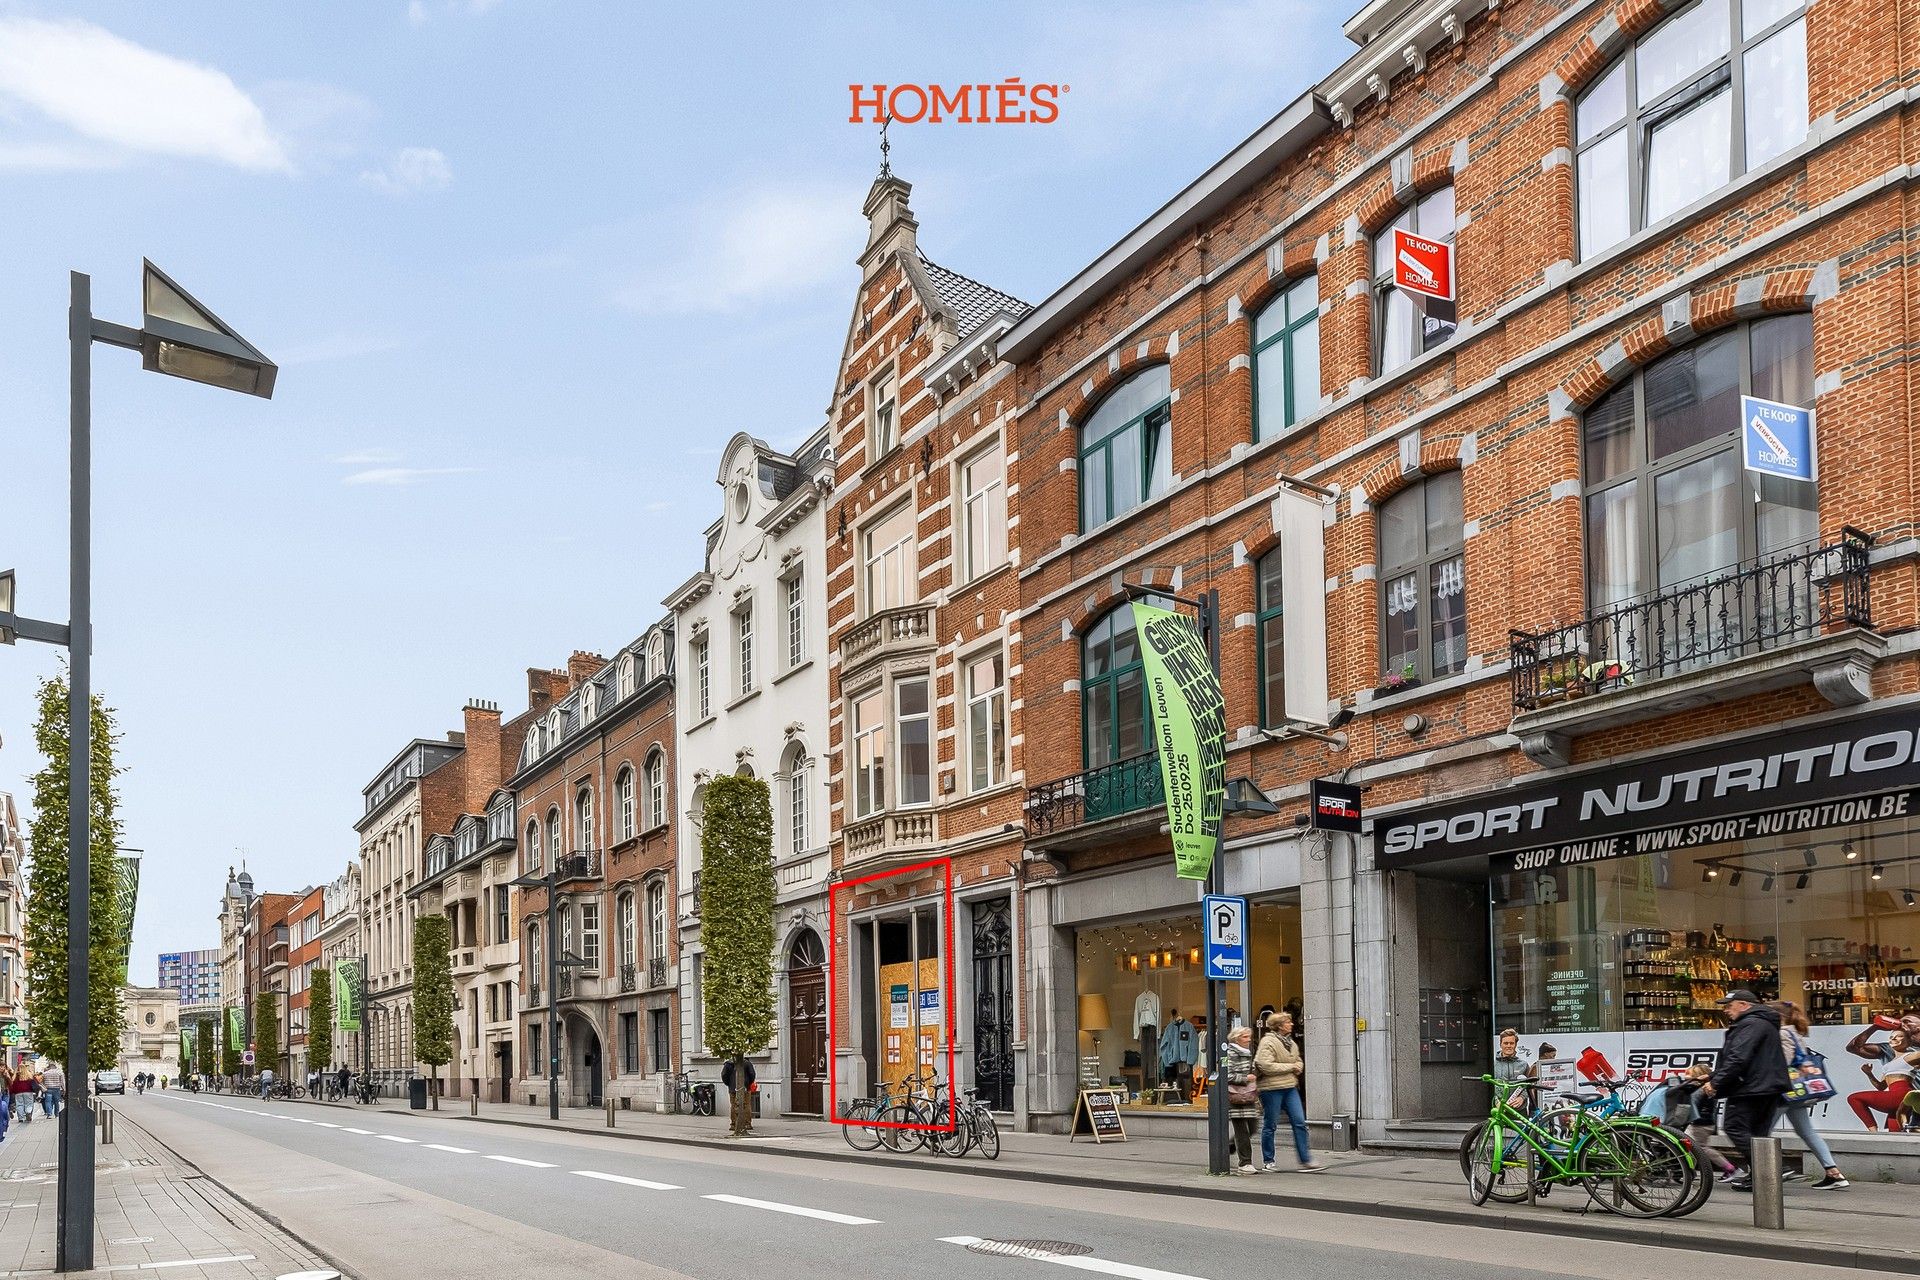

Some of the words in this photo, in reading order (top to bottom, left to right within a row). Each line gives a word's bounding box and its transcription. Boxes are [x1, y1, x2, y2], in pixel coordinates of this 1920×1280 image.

[1405, 237, 1415, 248] TE
[1416, 240, 1439, 254] KOOP
[1758, 406, 1770, 419] TE
[1771, 409, 1797, 424] KOOP
[1755, 420, 1785, 455] VERKOCHT
[1154, 677, 1169, 719] Leuven
[1162, 724, 1183, 834] Studentenwelkom
[1177, 753, 1193, 811] 25.09.25
[1319, 796, 1351, 812] SPORT
[1184, 813, 1194, 834] Do
[1384, 797, 1559, 854] SPORT
[1514, 847, 1556, 871] SHOP
[1559, 838, 1619, 864] ONLINE
[1636, 792, 1910, 853] WWW.SPORT-NUTRITION.BE
[1218, 912, 1232, 938] P
[1223, 966, 1234, 975] 150
[1235, 967, 1243, 976] PL
